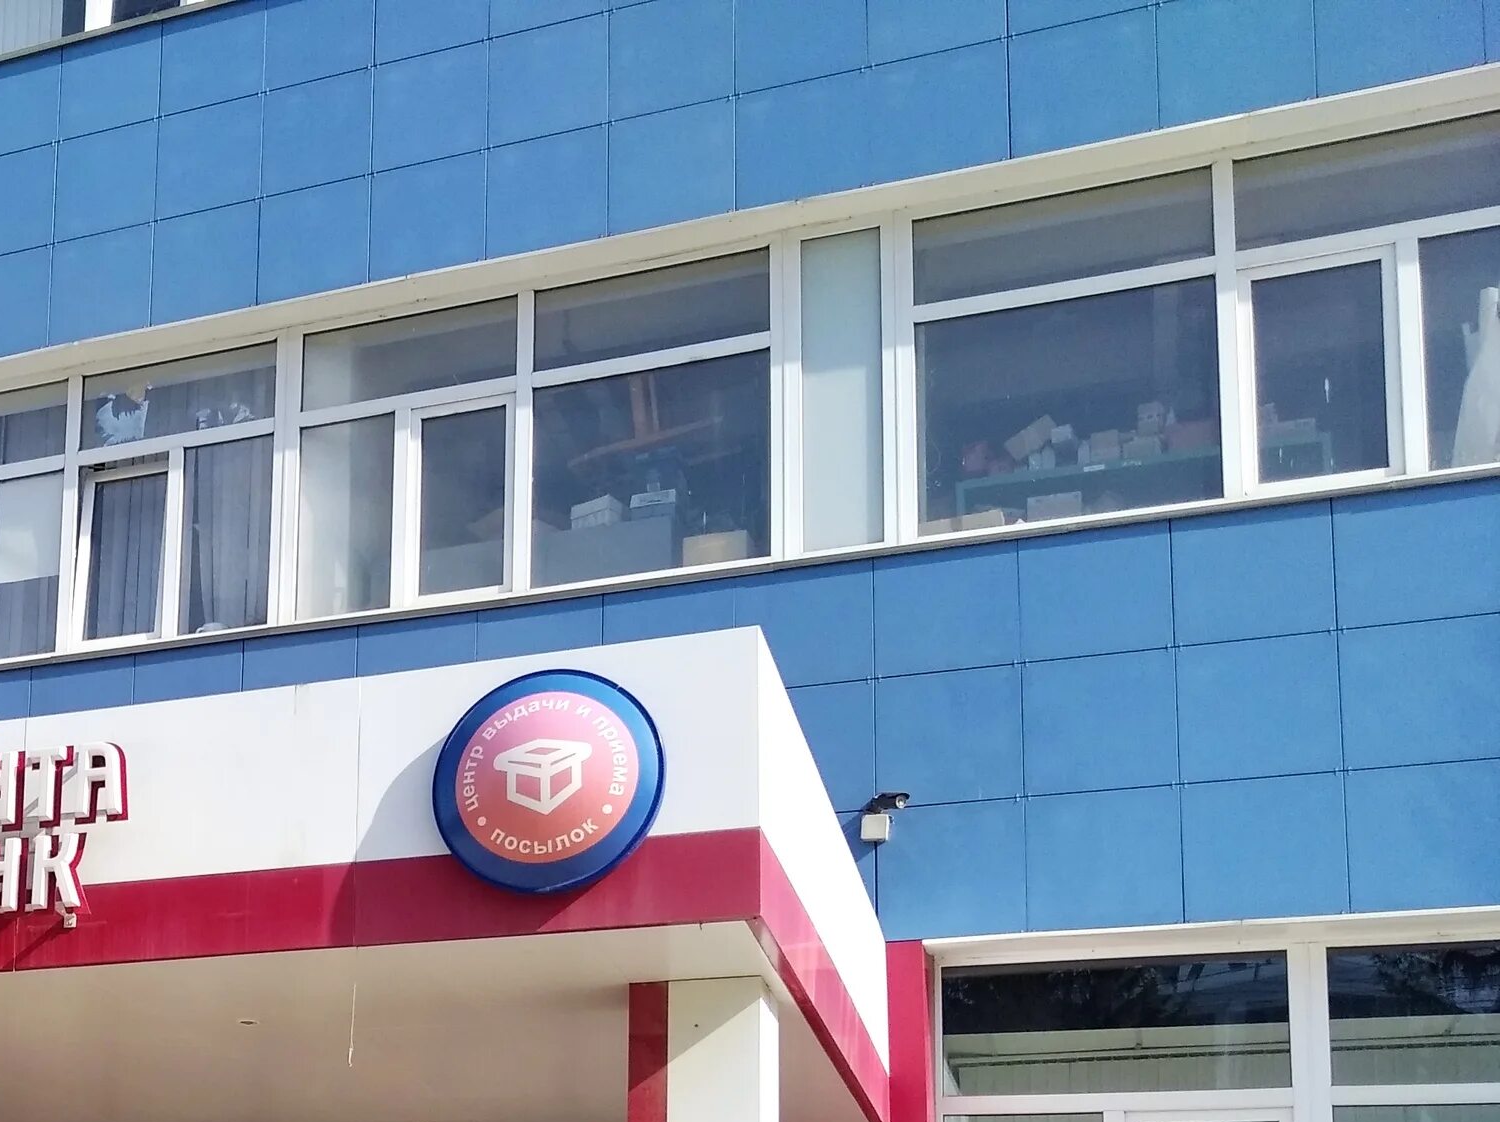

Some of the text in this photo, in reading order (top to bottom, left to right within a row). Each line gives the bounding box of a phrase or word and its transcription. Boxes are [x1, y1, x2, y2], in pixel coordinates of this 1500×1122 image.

[462, 697, 630, 812] центр выдачи и приема
[489, 817, 600, 855] посылок
